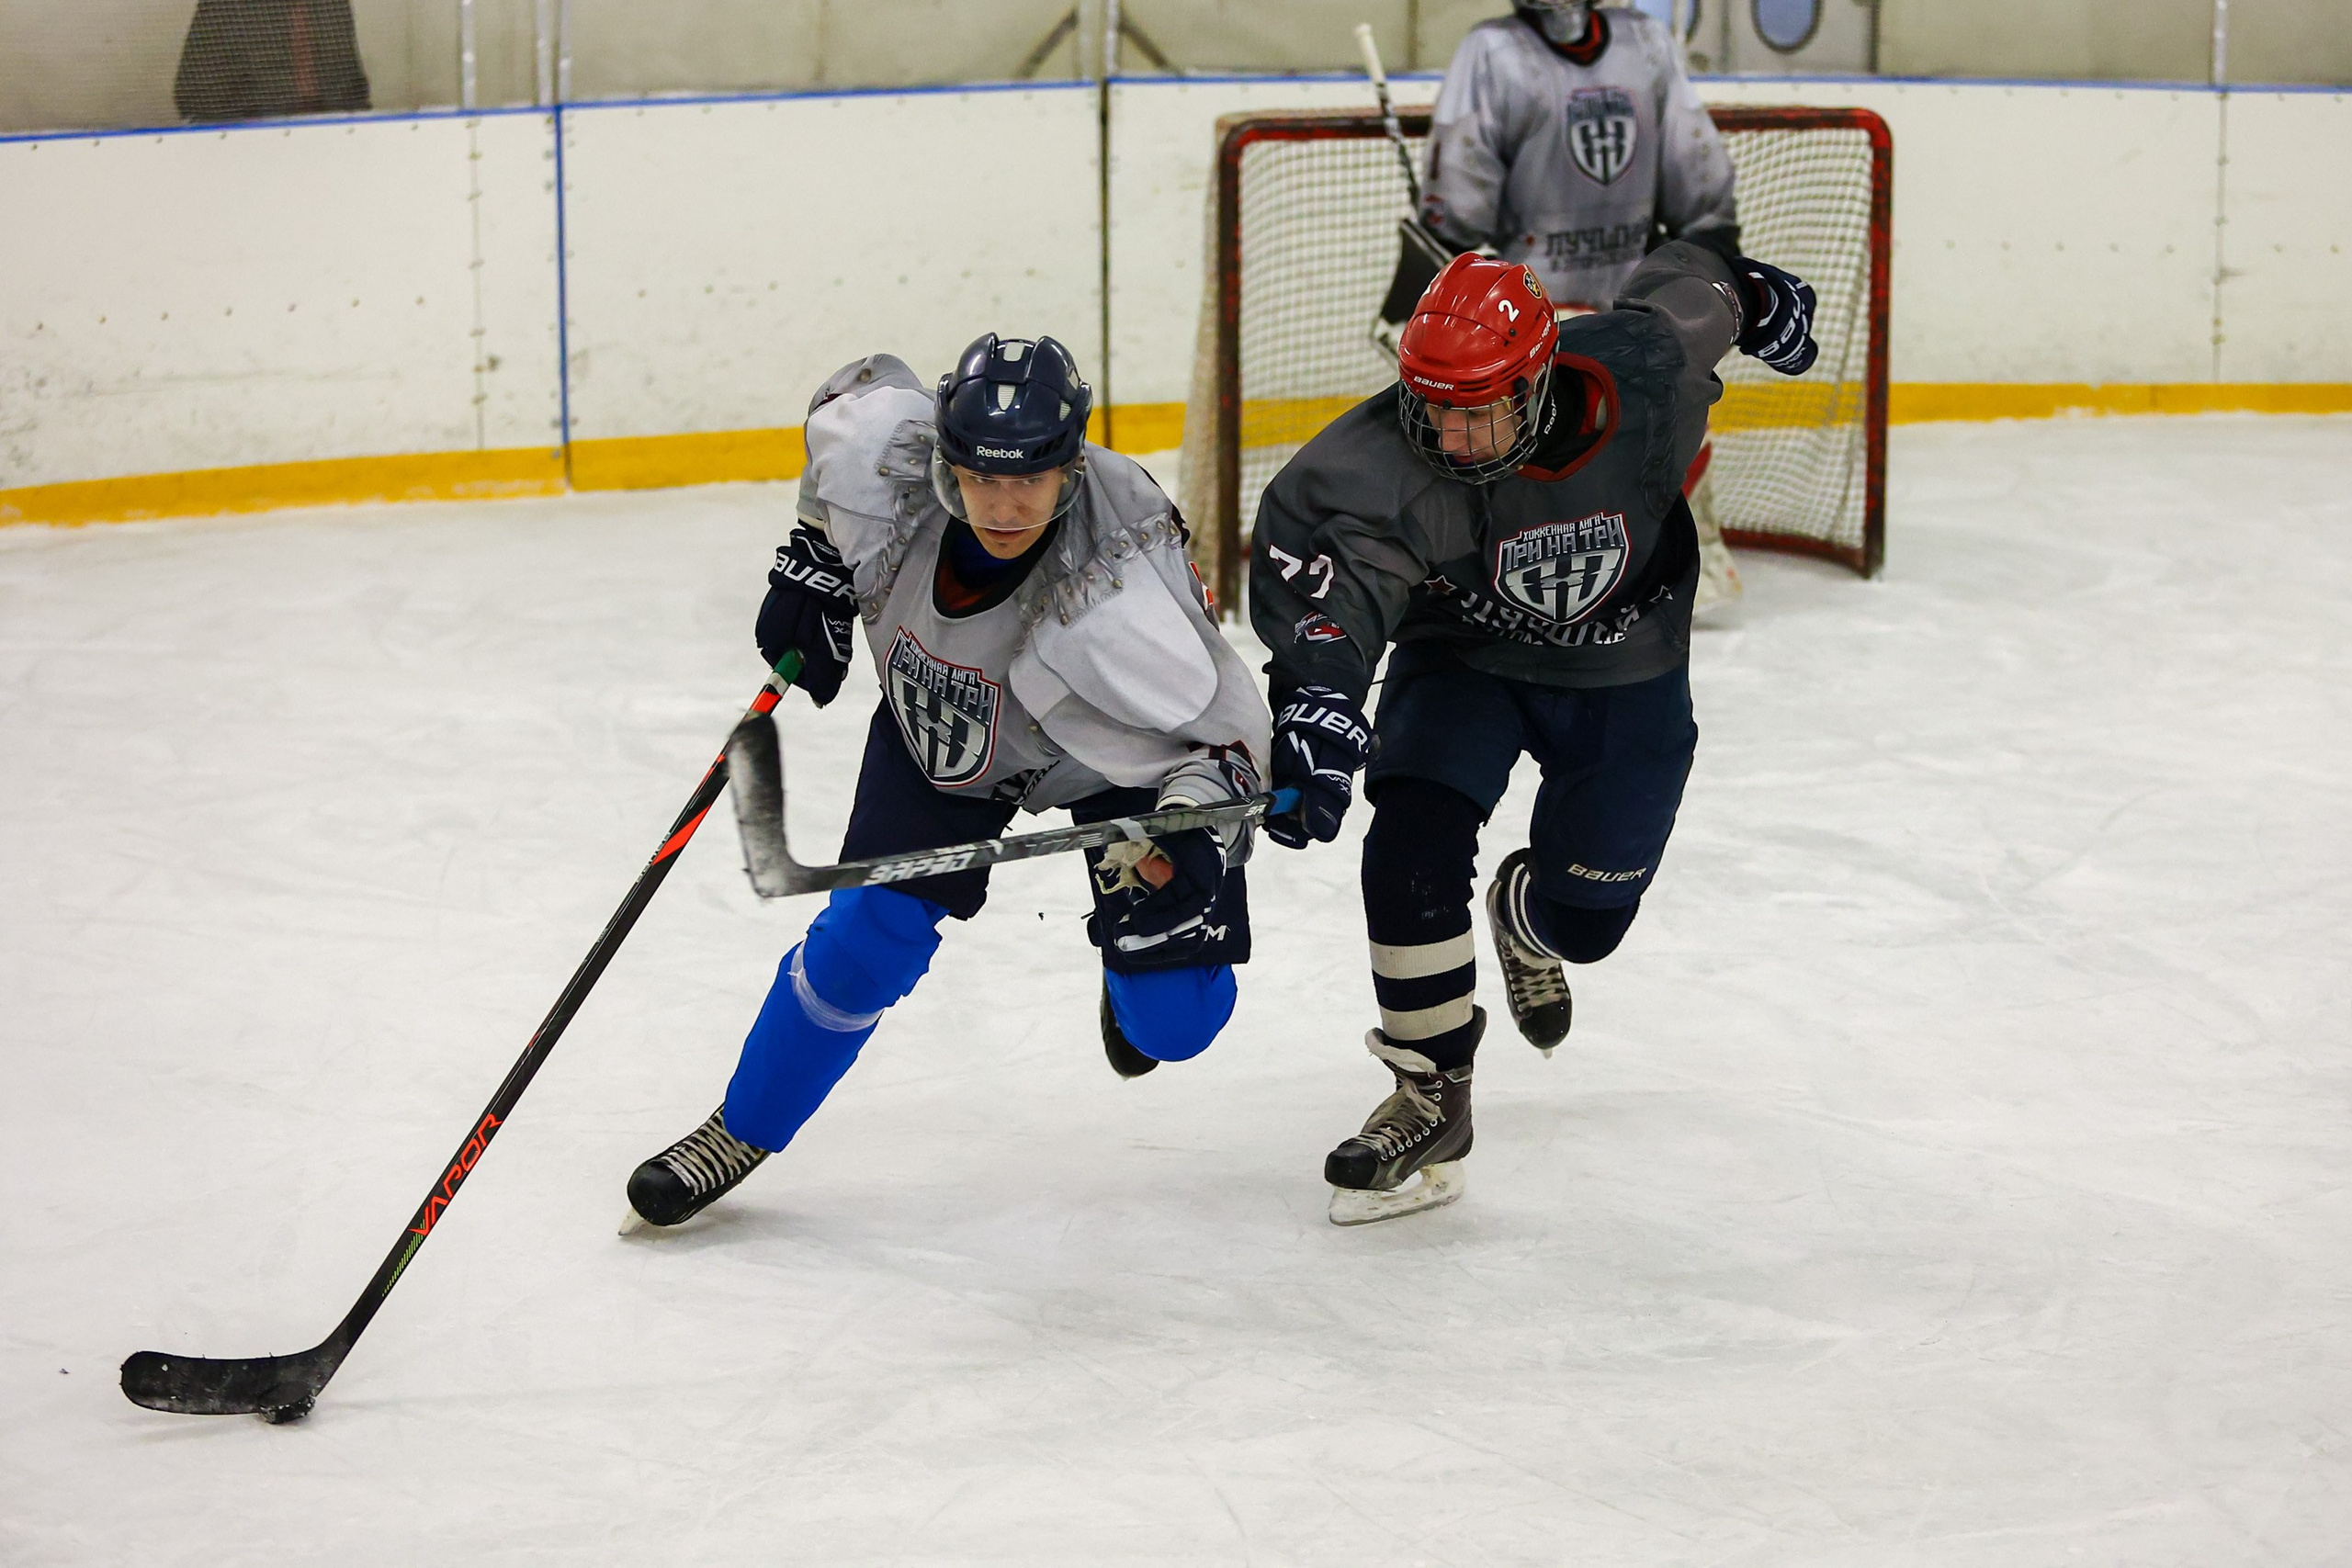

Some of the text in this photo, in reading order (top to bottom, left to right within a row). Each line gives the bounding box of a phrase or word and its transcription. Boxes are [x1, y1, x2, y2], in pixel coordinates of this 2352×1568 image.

[1498, 299, 1520, 322] 2
[1413, 376, 1455, 390] BAUER
[976, 445, 1024, 459] Reebok
[774, 552, 857, 606] AUER
[1277, 703, 1369, 753] AUER
[1567, 863, 1646, 882] BAUER
[408, 1113, 503, 1236] VAPOR
